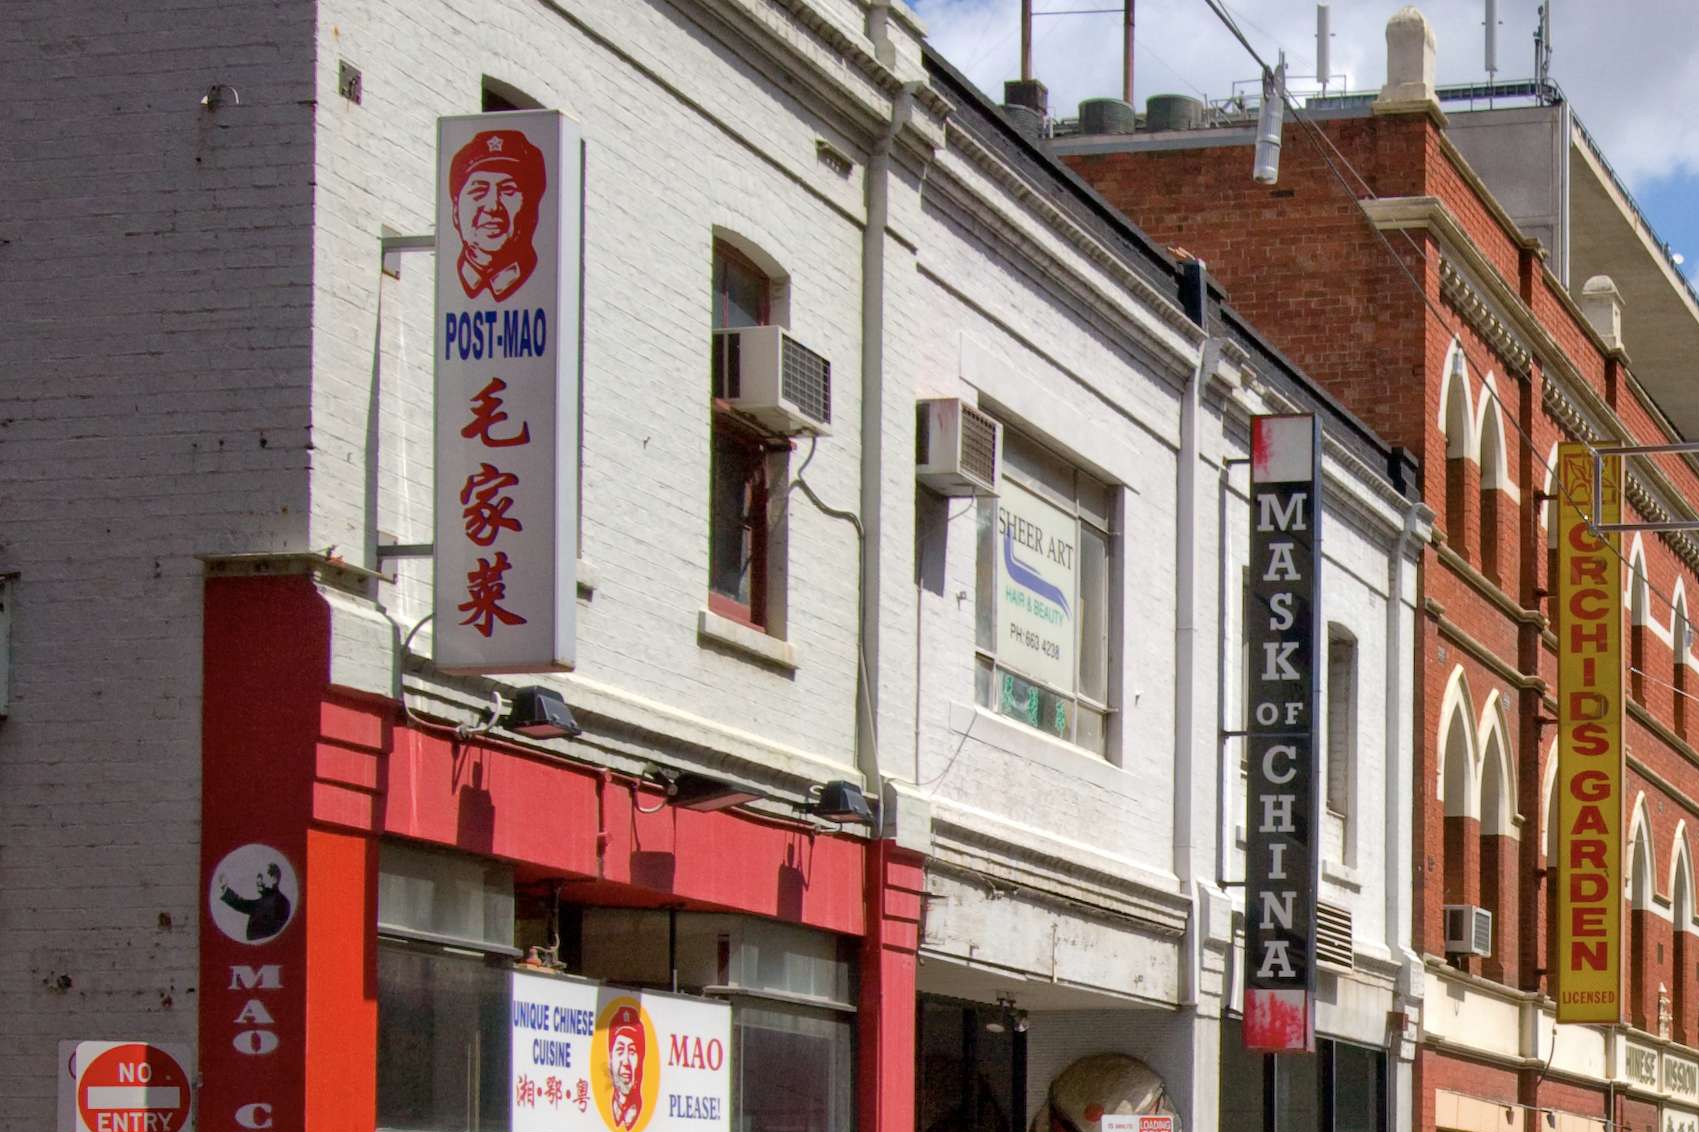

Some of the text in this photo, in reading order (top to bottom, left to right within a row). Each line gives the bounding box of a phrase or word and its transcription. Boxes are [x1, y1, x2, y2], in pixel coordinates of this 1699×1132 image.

[445, 307, 547, 362] POST-MAO
[458, 376, 531, 638] 毛家菜
[1000, 506, 1075, 571] SHEER ART
[1005, 586, 1025, 608] HAIR
[1033, 596, 1064, 628] BEAUTY
[1256, 492, 1307, 682] MASK
[1570, 521, 1609, 757] ORCHIDS
[1256, 702, 1304, 727] OF
[1258, 744, 1298, 979] CHINA
[1570, 770, 1610, 972] GARDEN
[228, 964, 284, 1055] MAO
[1562, 991, 1616, 1005] LICENSED
[513, 1001, 594, 1037] UNIQUE CHINESE
[532, 1038, 571, 1068] CUISINE
[668, 1033, 724, 1072] MAO
[118, 1062, 153, 1084] NO
[96, 1112, 174, 1132] ENTRY
[669, 1093, 721, 1121] PLEASE!
[1140, 1120, 1171, 1129] LOADING
